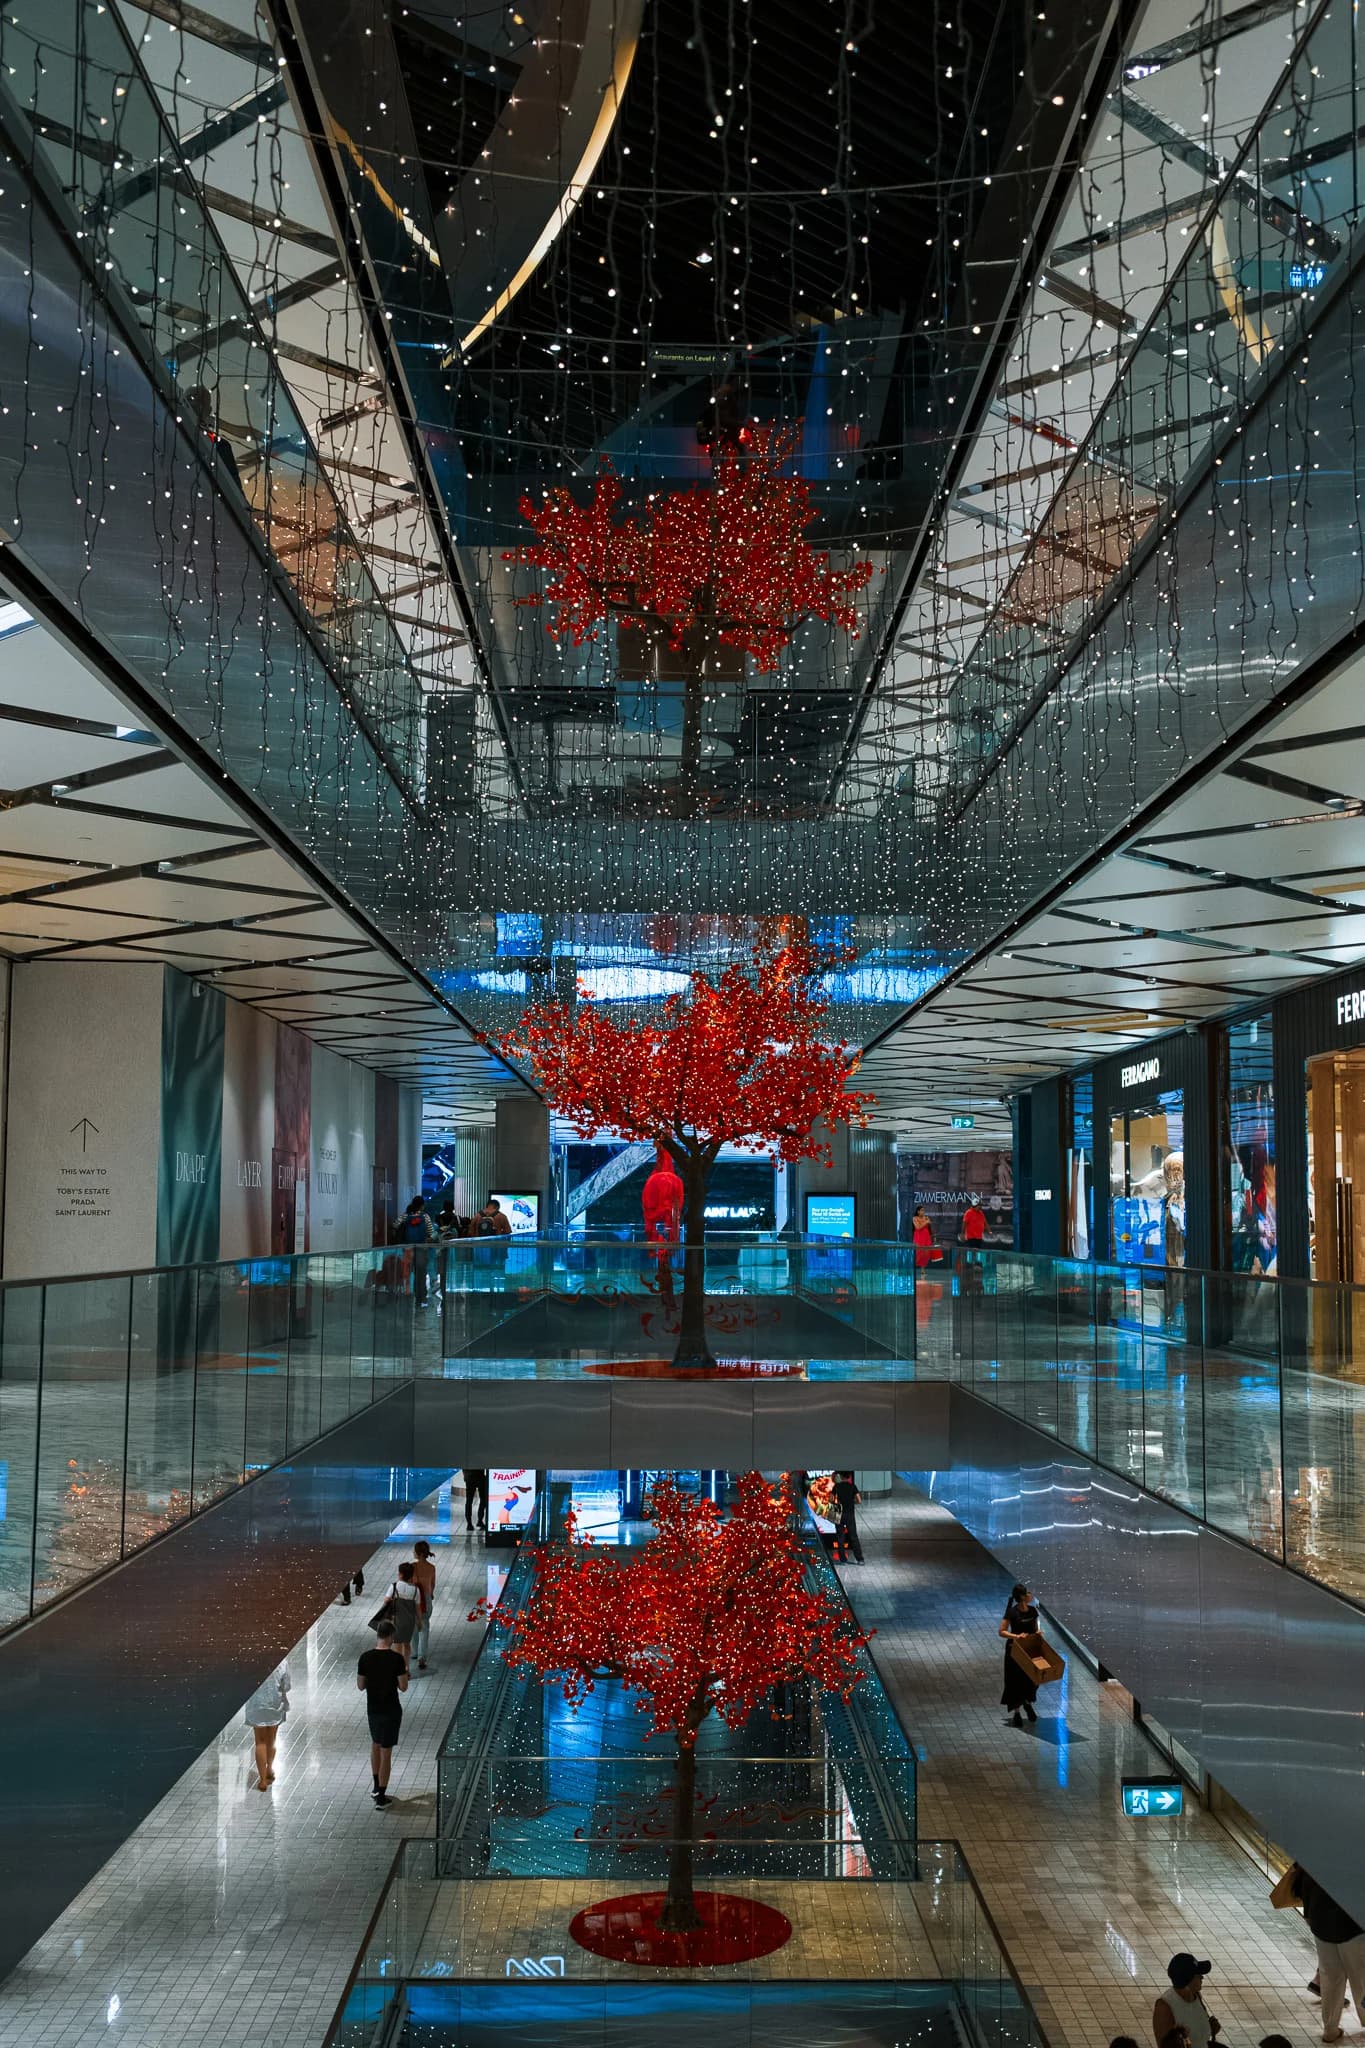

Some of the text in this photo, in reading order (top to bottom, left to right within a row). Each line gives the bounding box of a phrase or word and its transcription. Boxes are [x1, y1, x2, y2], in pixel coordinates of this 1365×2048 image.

[694, 354, 712, 362] Level
[1121, 1057, 1160, 1088] FERRAGAMO
[176, 1151, 206, 1184] DRAPE
[237, 1160, 262, 1187] LAYER
[703, 1206, 730, 1217] AINT
